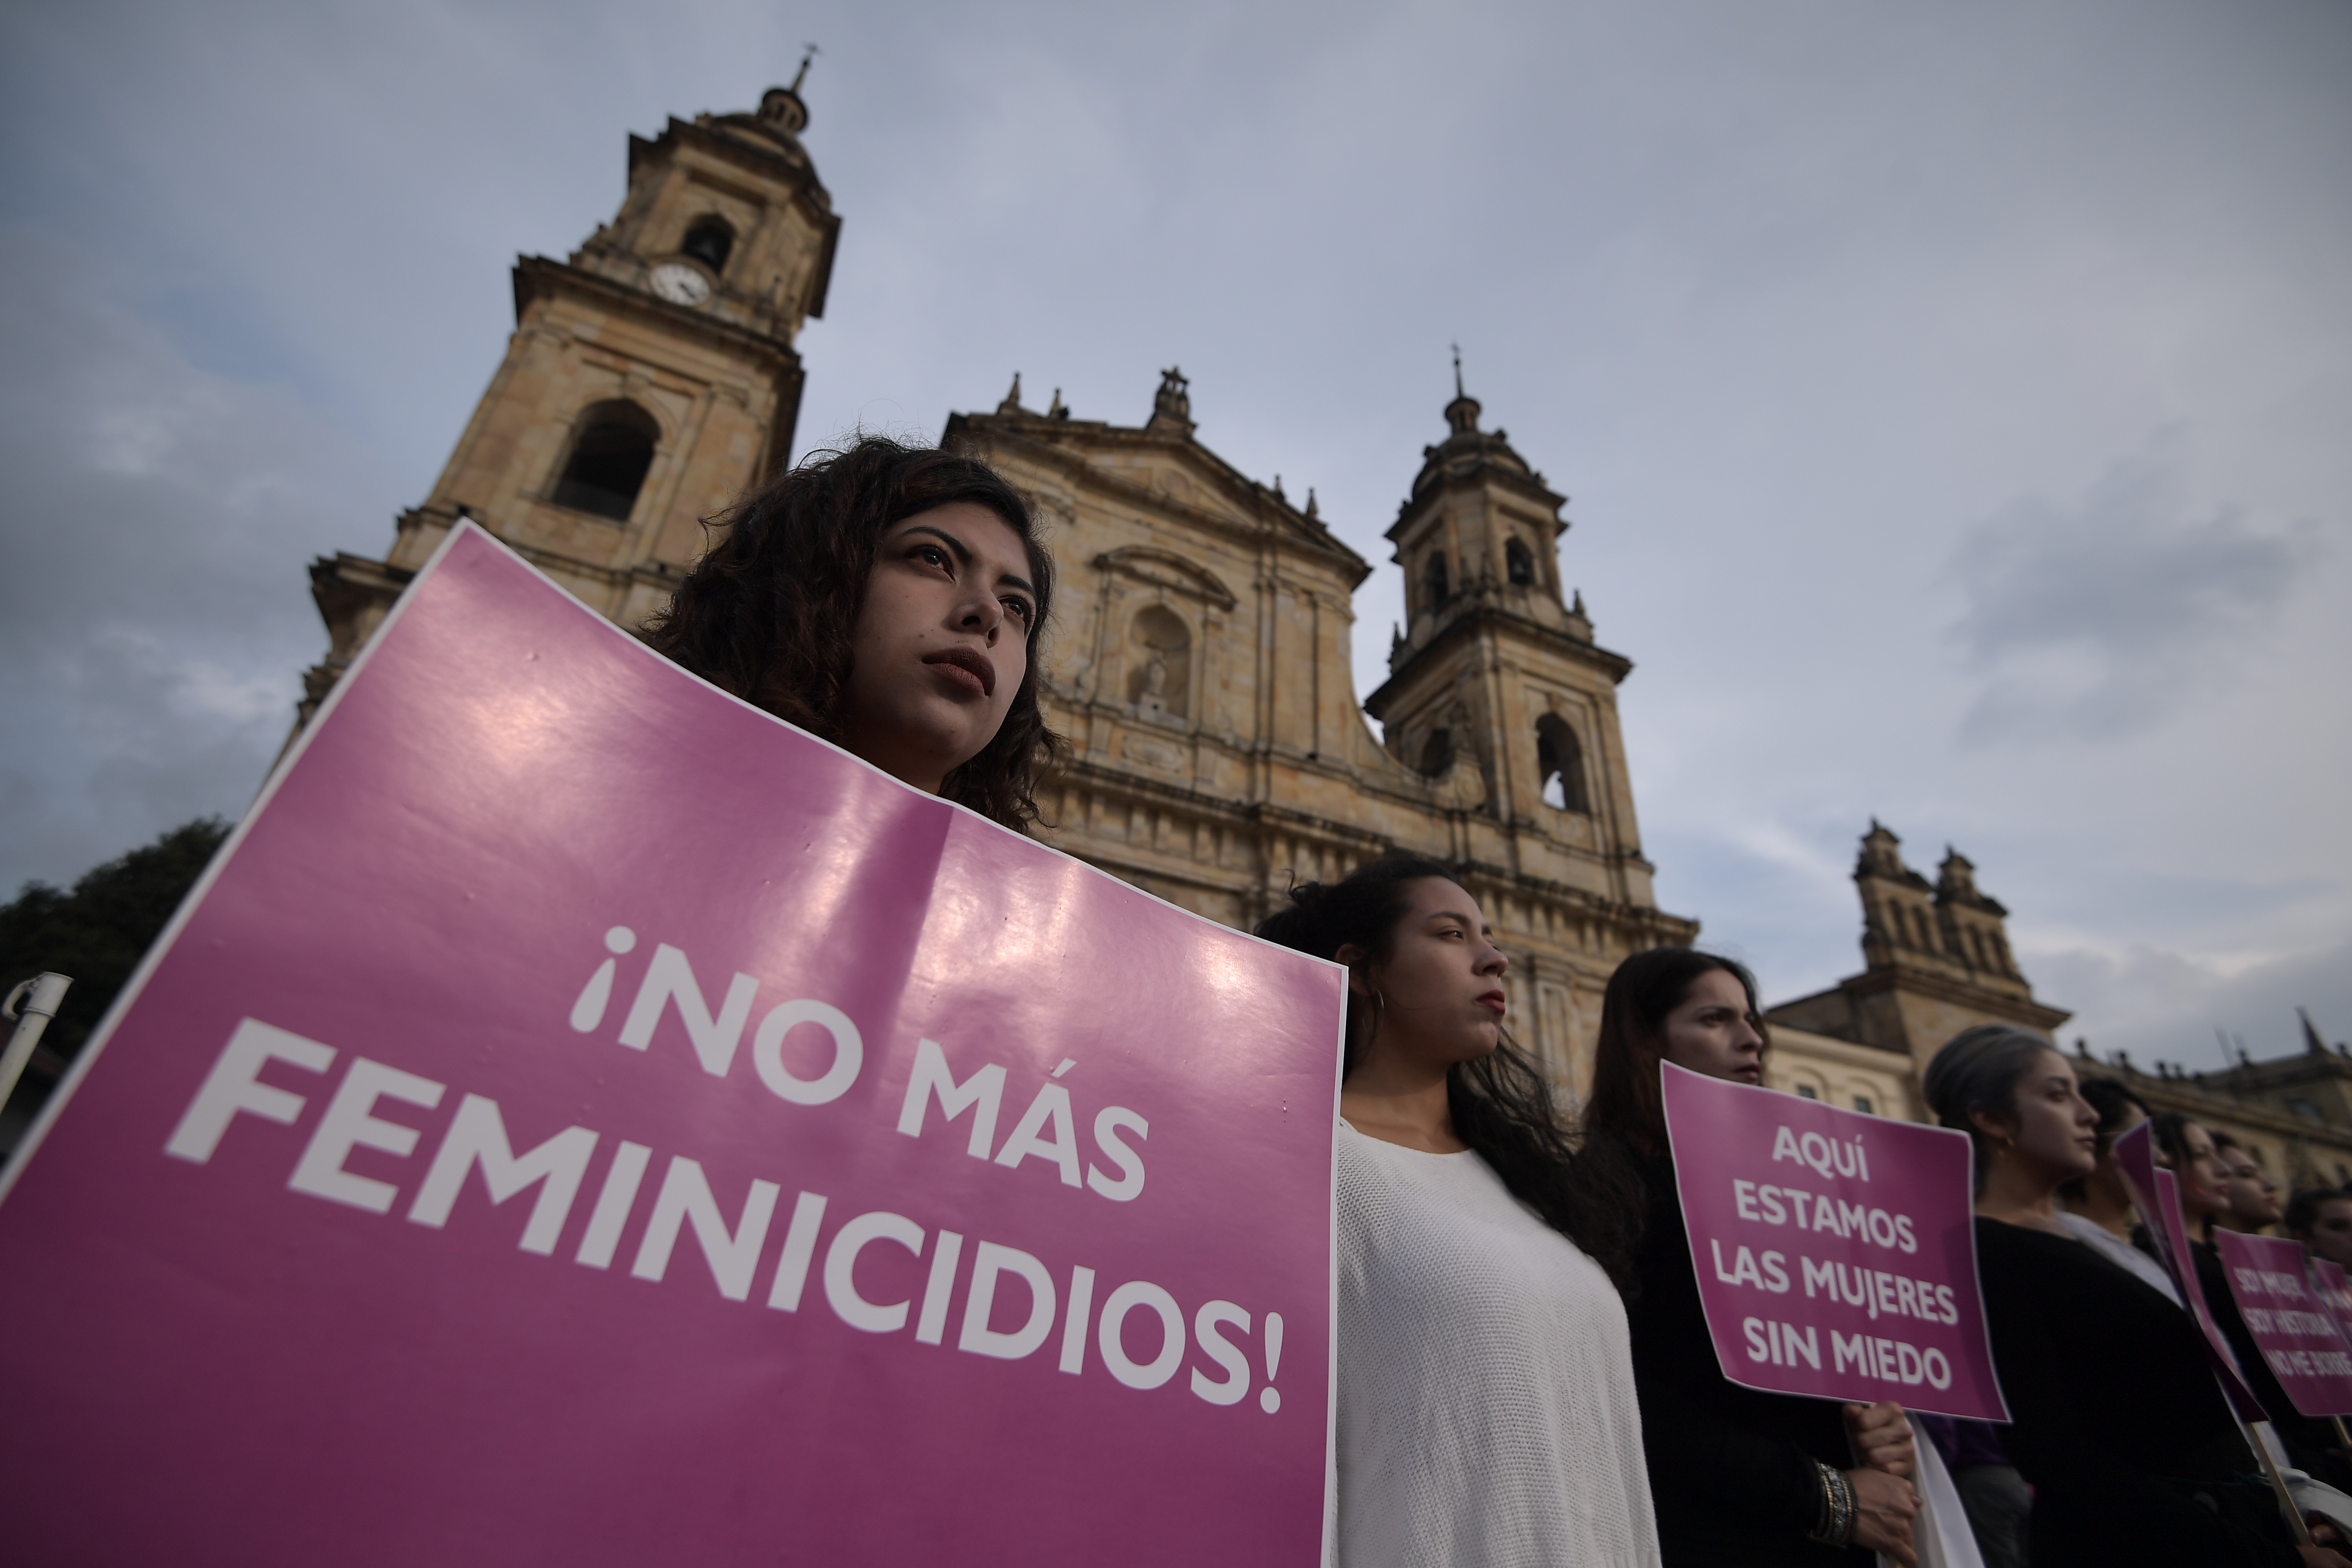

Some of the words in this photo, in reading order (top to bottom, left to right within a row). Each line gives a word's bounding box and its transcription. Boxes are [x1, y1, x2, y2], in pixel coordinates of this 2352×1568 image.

[569, 925, 864, 1106] ¡NO
[896, 1036, 1149, 1202] MÁS
[1771, 1125, 1870, 1182] AQUÍ
[164, 1016, 1284, 1414] FEMINICIDIOS!
[1732, 1178, 1917, 1254] ESTAMOS
[1710, 1238, 1790, 1294] LAS
[1800, 1255, 1958, 1325] MUJERES
[1742, 1316, 1821, 1370] SIN
[1830, 1329, 1952, 1390] MIEDO
[2243, 1307, 2274, 1334] SOY
[2265, 1349, 2294, 1376] NO
[2286, 1350, 2316, 1377] ME
